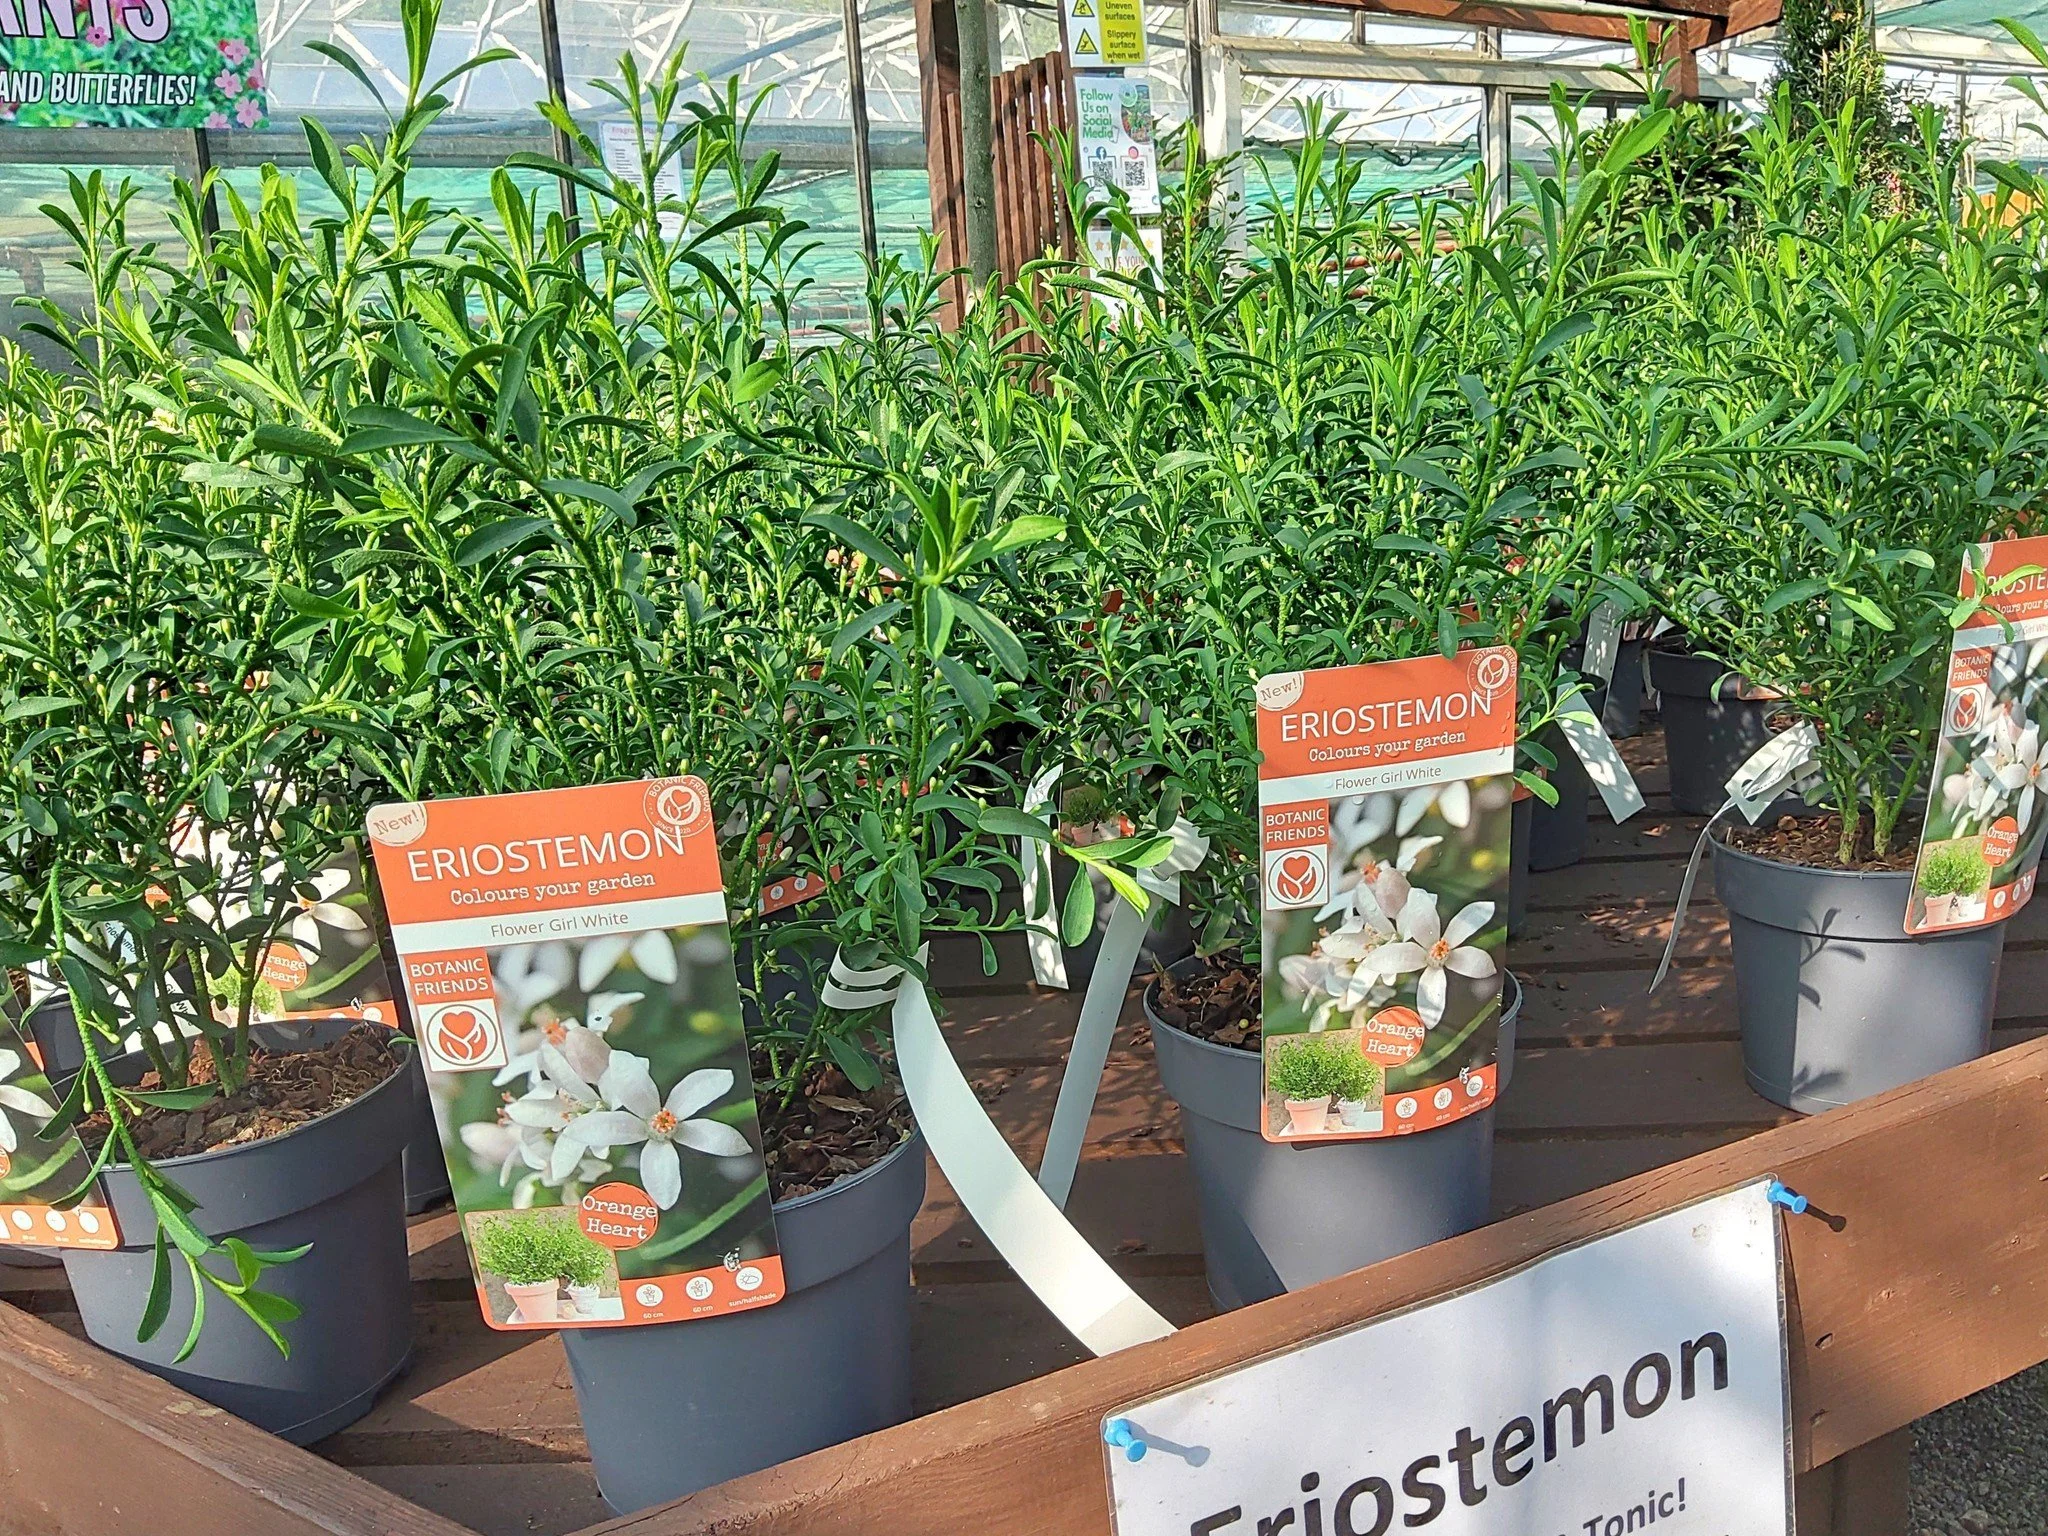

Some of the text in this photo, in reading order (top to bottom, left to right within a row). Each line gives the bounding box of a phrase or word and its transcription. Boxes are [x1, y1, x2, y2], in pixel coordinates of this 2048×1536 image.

[1105, 1, 1133, 10] Uneven
[1104, 12, 1136, 20] surfaces
[1106, 30, 1137, 40] Slippery
[1109, 41, 1136, 49] surface
[1106, 51, 1141, 60] when wet
[0, 72, 196, 105] AND BUTTERFLIES!
[1080, 88, 1113, 101] Follow
[1081, 101, 1109, 113] Us on
[1082, 113, 1112, 126] Social
[1082, 127, 1113, 138] Media
[2021, 600, 2043, 614] your
[1472, 647, 1517, 678] BOTANIC FRIENDS
[1954, 654, 1990, 668] BOTANIC
[1953, 668, 1988, 682] FRIENDS
[1260, 677, 1299, 701] New!
[1281, 688, 1492, 742] ERIOSTEMON
[1309, 731, 1466, 762] Colours your garden
[1335, 765, 1442, 790] Flower Girl White
[649, 777, 712, 812] BOTANIC FRIENDS
[373, 809, 419, 835] New!
[1266, 808, 1326, 827] BOTANIC
[1266, 826, 1326, 843] FRIENDS
[1987, 826, 2019, 844] Orange
[407, 825, 685, 882] ERIOSTEMON
[1984, 843, 2011, 858] Heart
[450, 873, 656, 906] Colours your garden
[491, 912, 629, 938] Flower Girl White
[268, 955, 306, 972] range
[410, 958, 485, 977] BOTANIC
[414, 977, 489, 996] FRIENDS
[1366, 1018, 1426, 1040] Orange
[1366, 1038, 1414, 1058] Heart
[582, 1195, 658, 1221] Orange
[586, 1216, 648, 1240] Heart
[692, 1305, 702, 1313] 60
[728, 1292, 777, 1307] sun/halfshade
[1582, 1477, 1686, 1536] Tonic!
